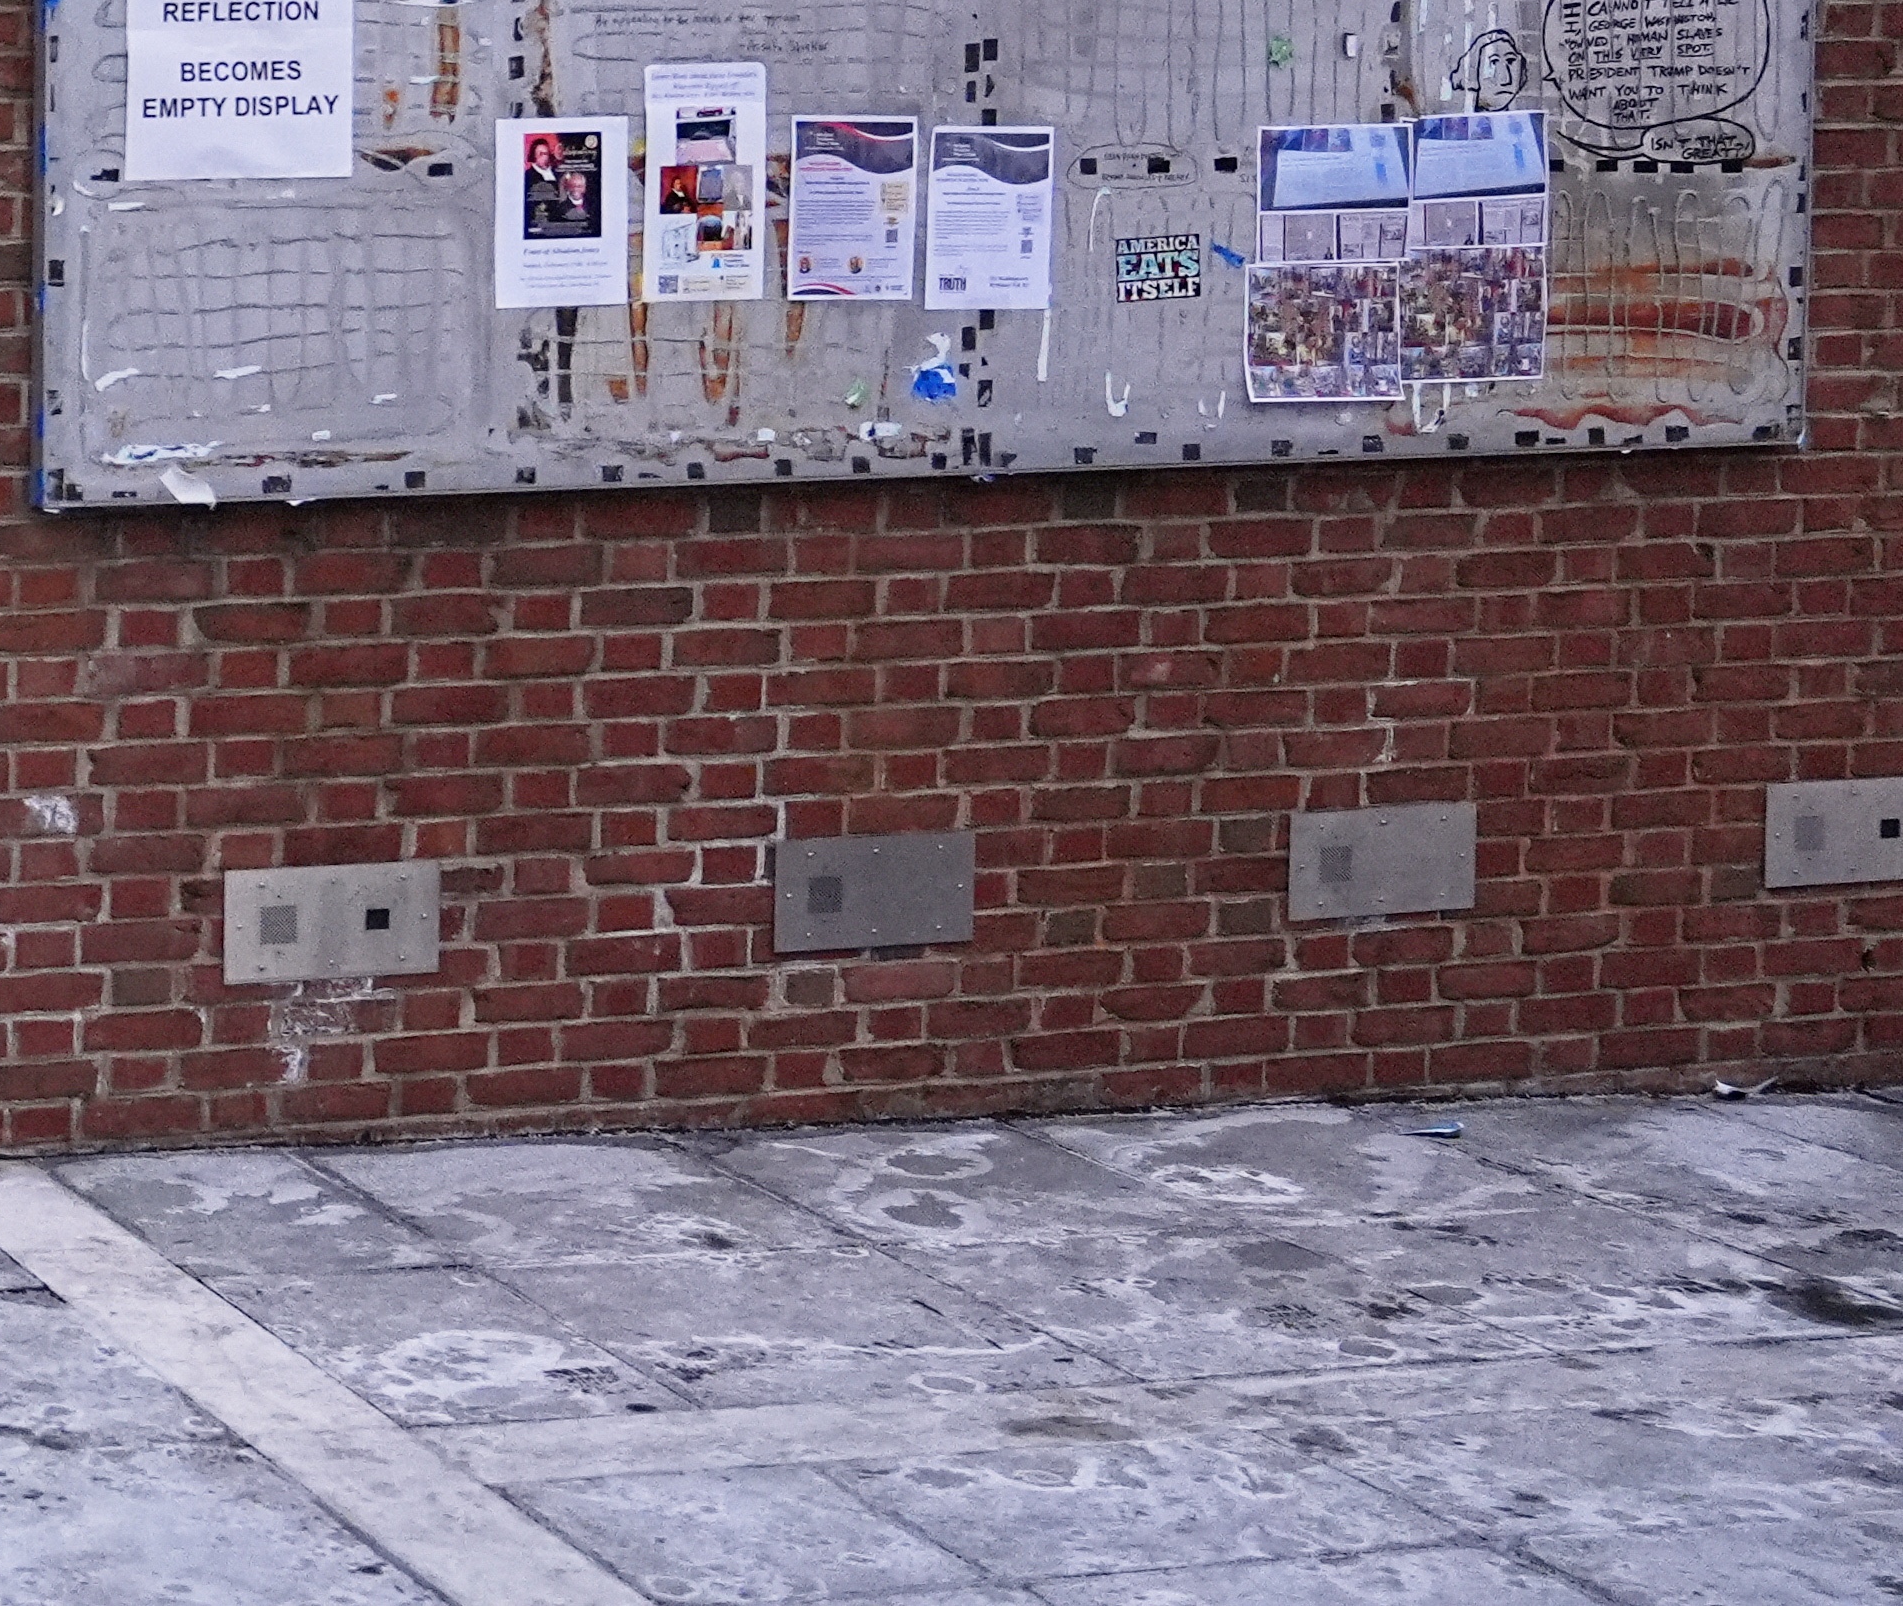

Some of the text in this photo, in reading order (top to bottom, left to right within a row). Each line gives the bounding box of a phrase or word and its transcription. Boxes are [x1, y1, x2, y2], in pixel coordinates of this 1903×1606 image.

[163, 0, 320, 23] REFLECTION
[180, 61, 302, 82] BECOMES
[143, 95, 339, 119] EMPTY DISPLAY
[1117, 234, 1199, 255] AMERICA
[1117, 249, 1200, 281] EATS
[1117, 277, 1200, 302] ITSELF
